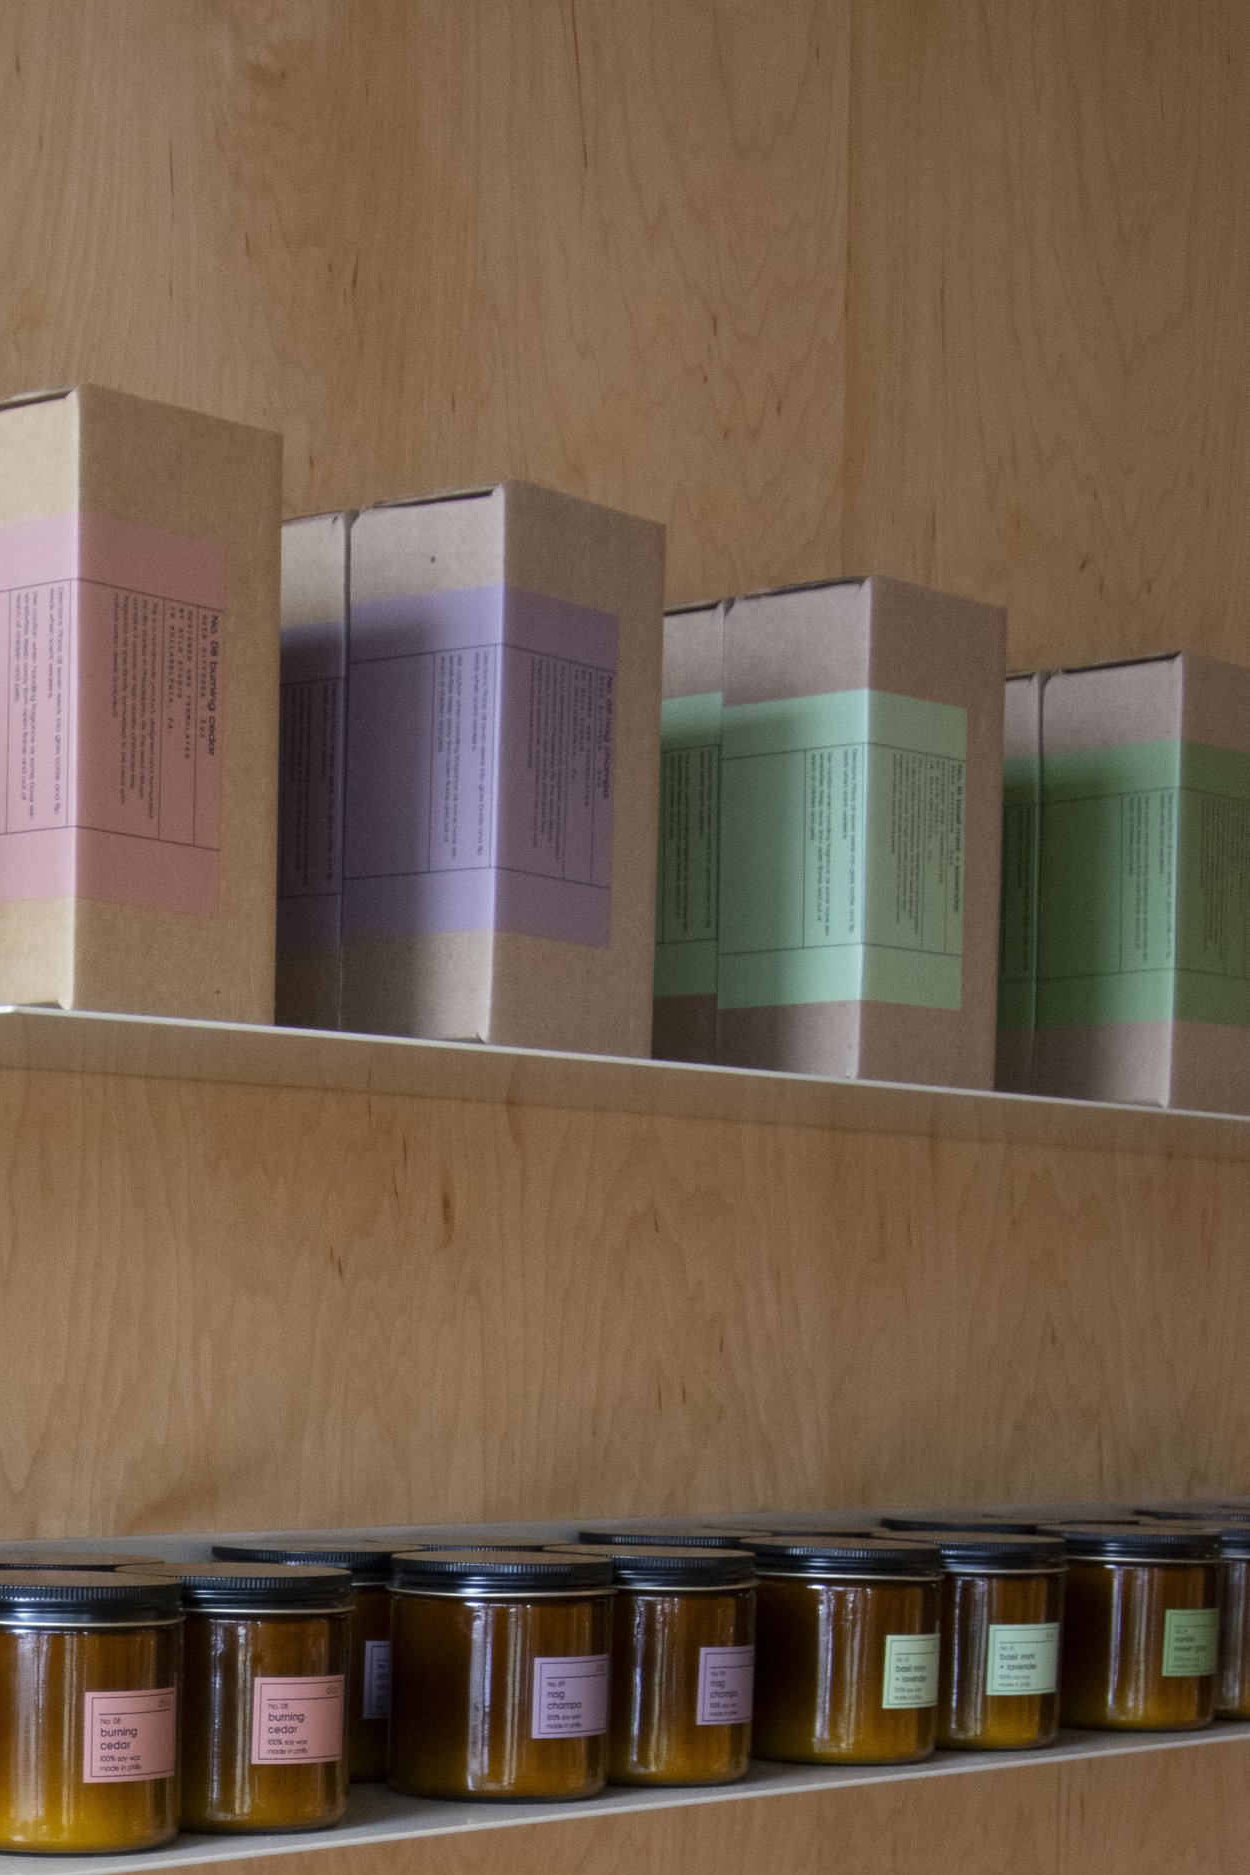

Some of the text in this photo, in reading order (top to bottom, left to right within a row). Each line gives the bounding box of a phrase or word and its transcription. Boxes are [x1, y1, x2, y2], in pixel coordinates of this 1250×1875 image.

[210, 640, 219, 657] 08
[207, 661, 219, 712] burning
[208, 715, 217, 756] cedar
[710, 1680, 725, 1689] nag
[547, 1691, 565, 1700] nag
[547, 1701, 582, 1710] champa
[112, 1717, 121, 1725] 08
[268, 1713, 305, 1723] burning
[100, 1727, 138, 1739] burning
[268, 1725, 298, 1734] cedar
[100, 1741, 131, 1750] cedar
